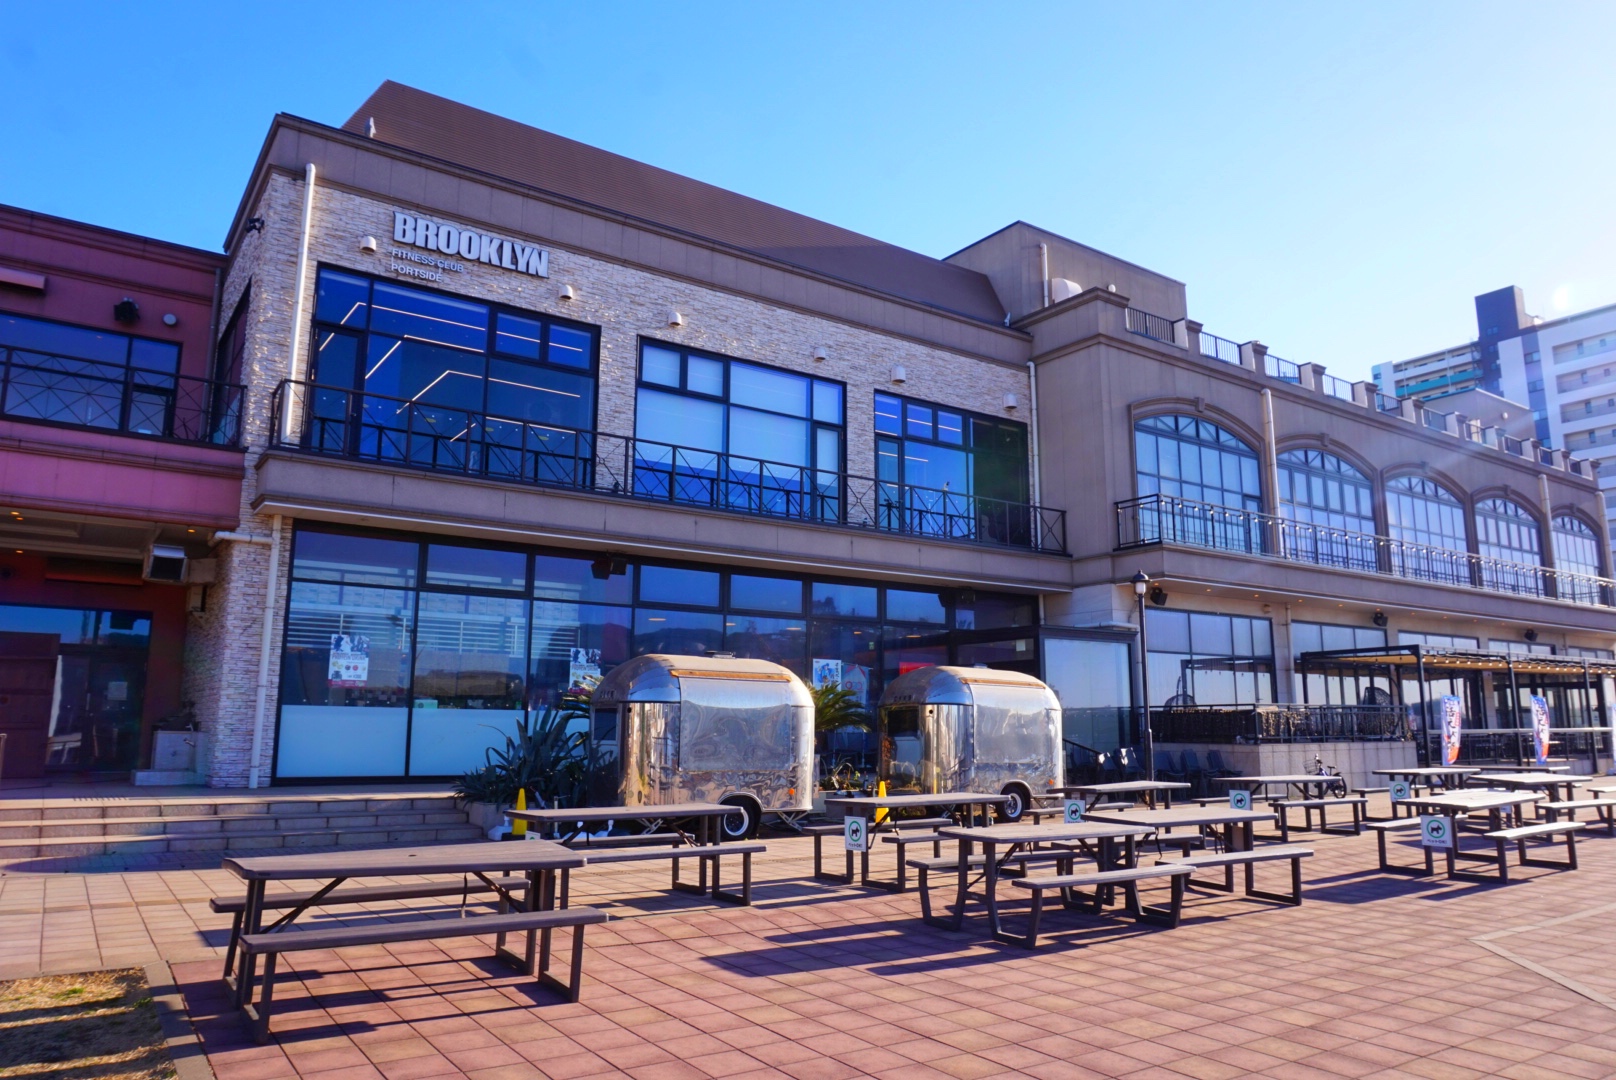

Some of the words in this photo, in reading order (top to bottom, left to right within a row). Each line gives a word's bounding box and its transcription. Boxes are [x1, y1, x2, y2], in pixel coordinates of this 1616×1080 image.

[393, 211, 549, 279] BROOKLYN
[391, 263, 443, 282] PORTSIDE
[392, 249, 435, 265] FITNESS
[437, 259, 464, 273] CLUB
